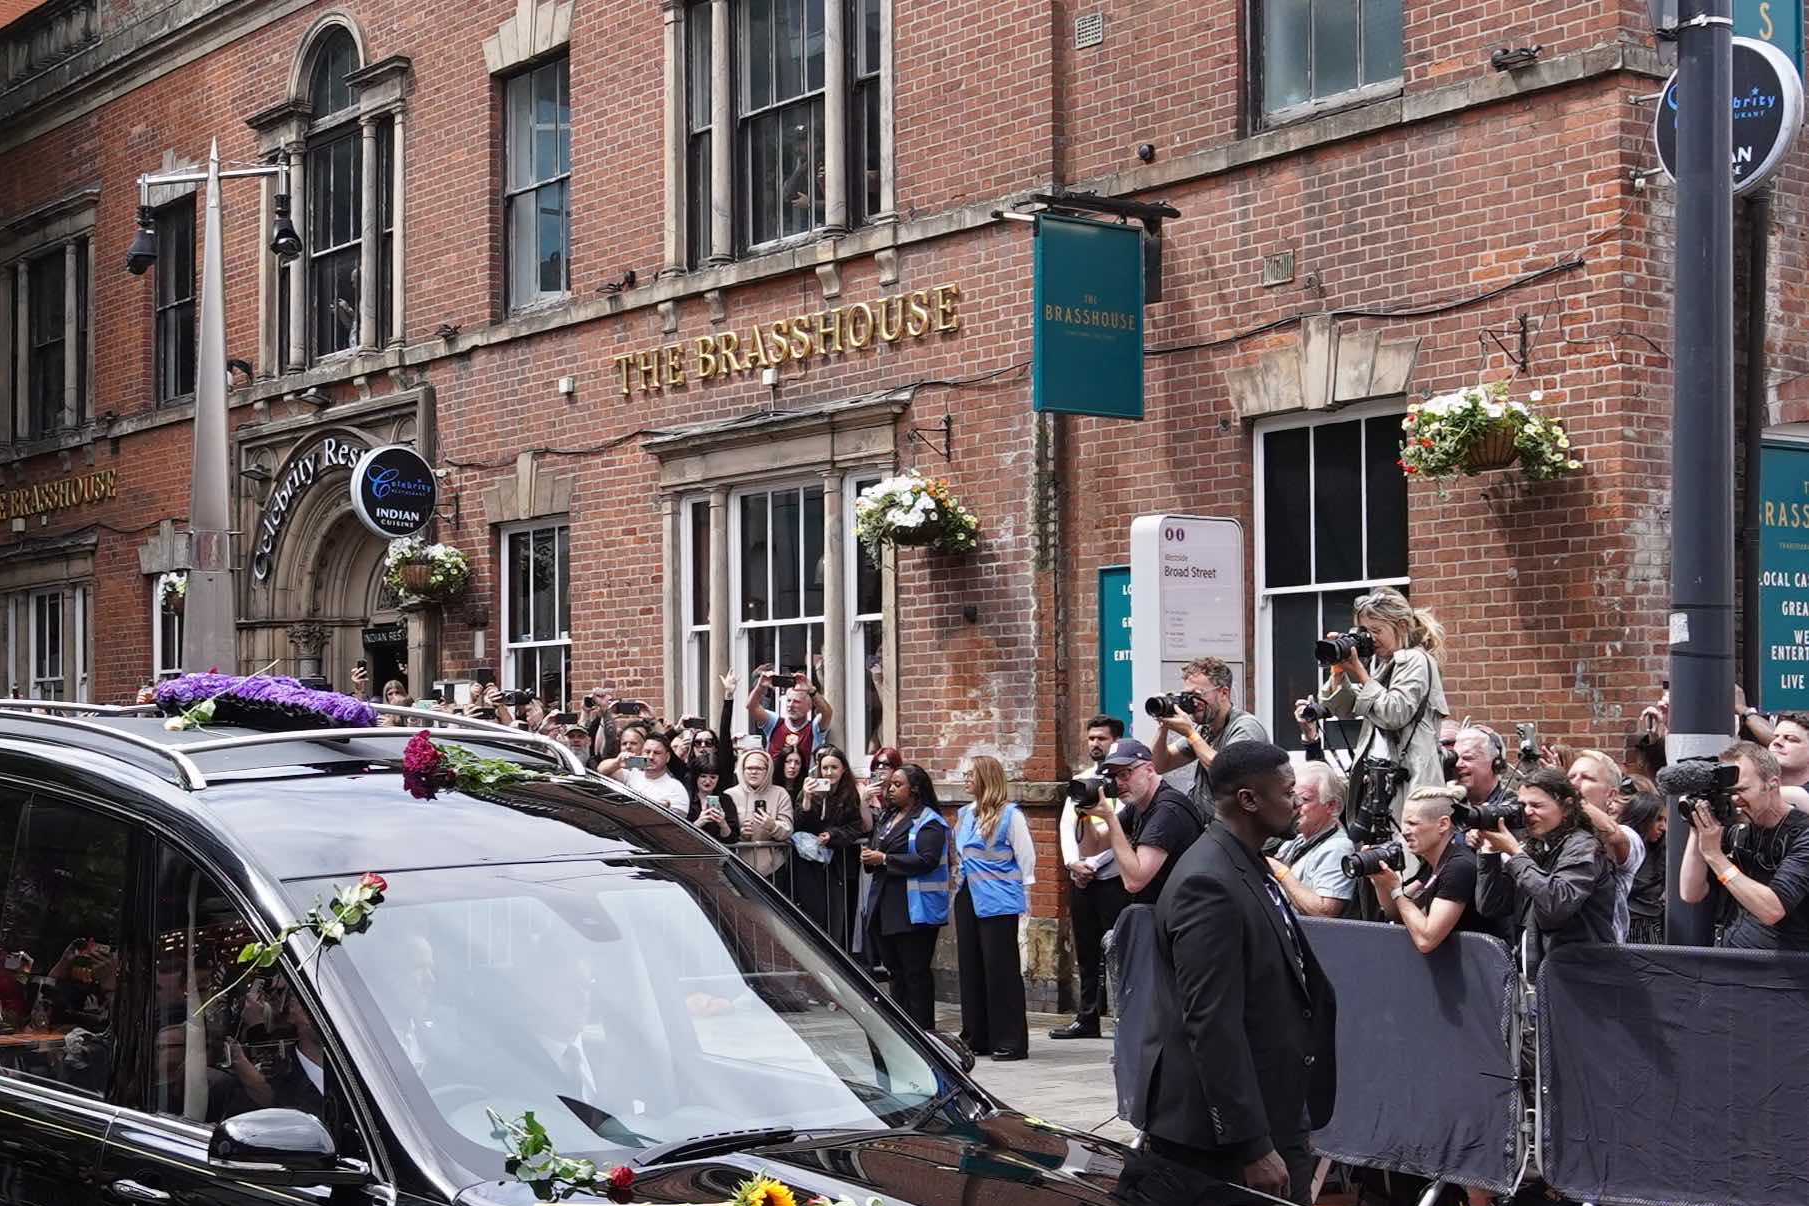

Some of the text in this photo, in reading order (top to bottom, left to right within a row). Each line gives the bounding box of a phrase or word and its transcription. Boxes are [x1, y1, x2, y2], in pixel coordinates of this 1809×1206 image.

[1045, 303, 1136, 331] BRASSHOUSE
[613, 283, 961, 396] THE BRASSHOUSE
[9, 468, 119, 516] BRASSHOUSE
[253, 452, 318, 580] Celebrity
[375, 507, 420, 522] INDIAN
[380, 518, 414, 528] CUISINE
[1758, 499, 1809, 529] RASS
[1164, 565, 1216, 579] Broad Street
[1781, 674, 1805, 690] LIVE
